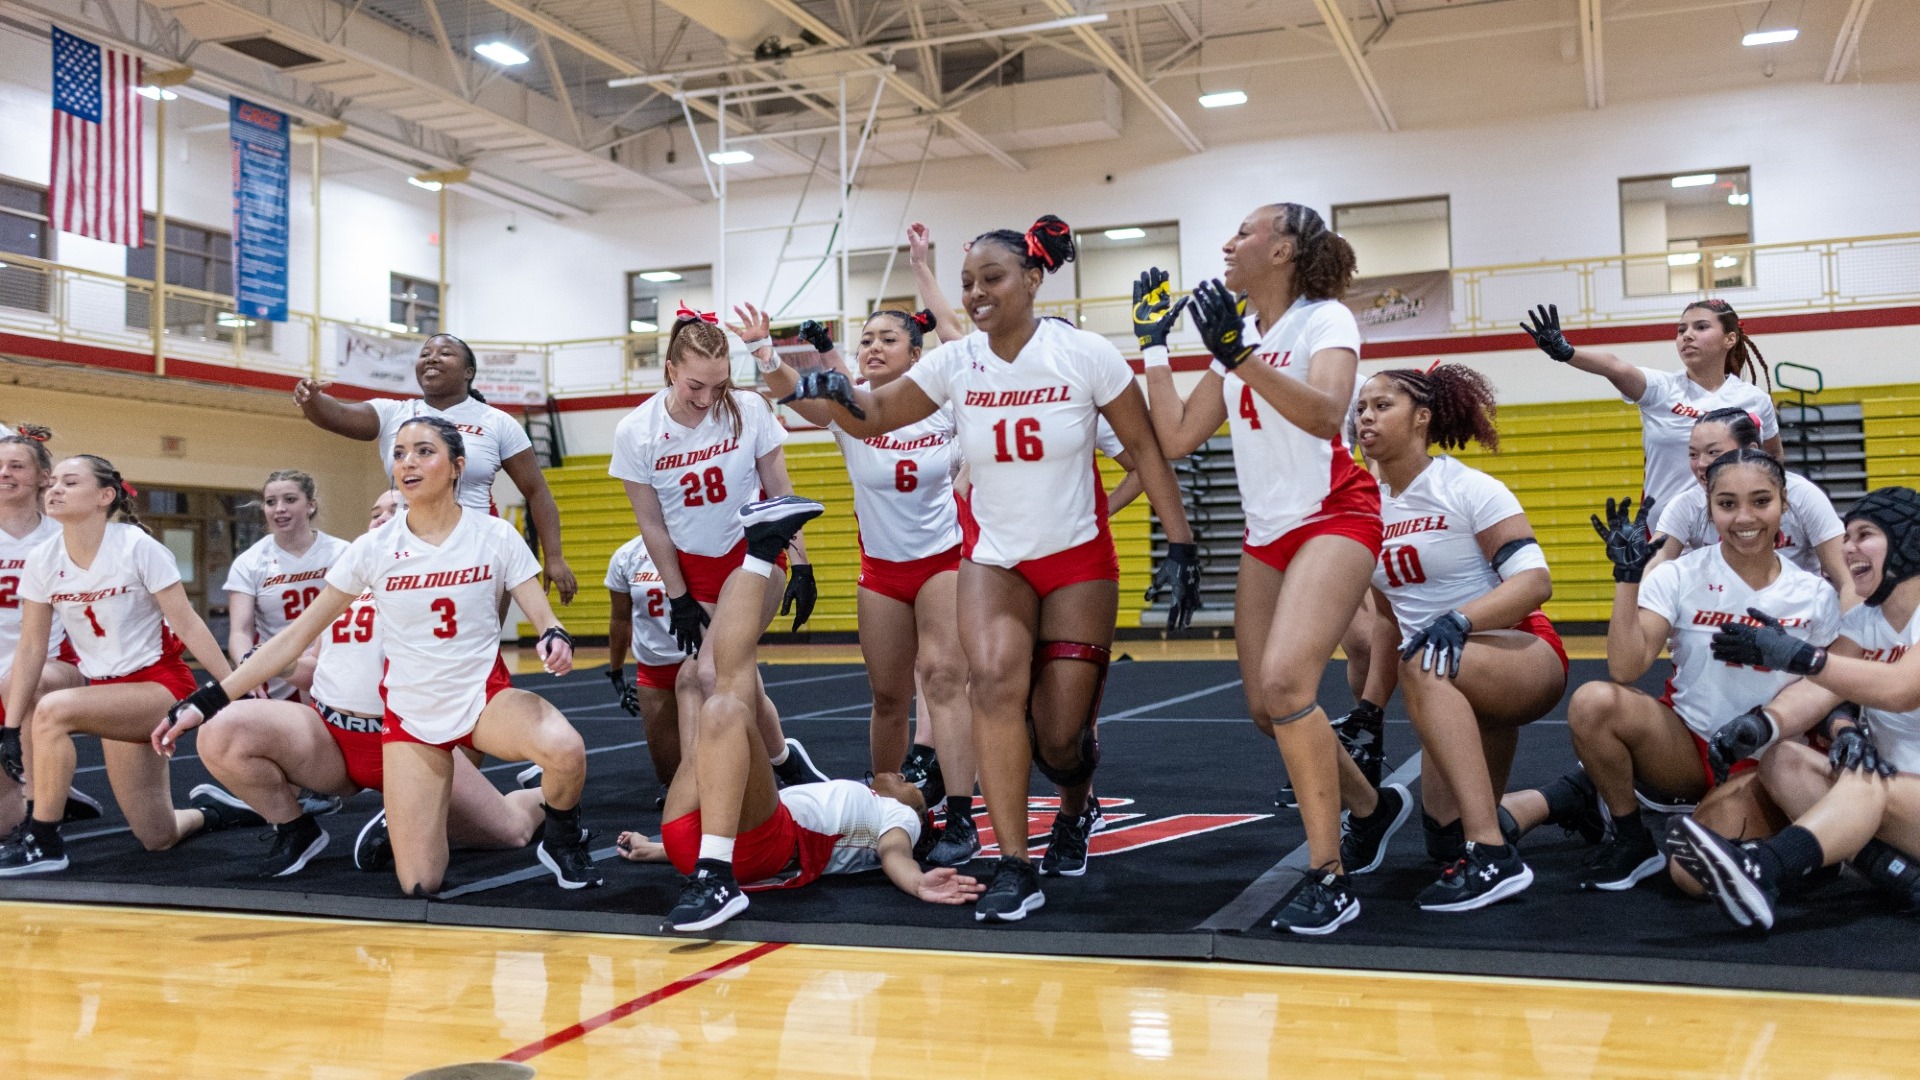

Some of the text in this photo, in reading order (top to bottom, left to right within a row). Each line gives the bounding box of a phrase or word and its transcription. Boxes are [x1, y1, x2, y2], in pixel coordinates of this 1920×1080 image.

[1239, 384, 1262, 430] 4
[993, 417, 1044, 462] 16
[680, 466, 728, 507] 28
[895, 459, 918, 493] 6
[1381, 545, 1427, 588] 10
[83, 605, 106, 637] 1
[332, 606, 376, 643] 29
[430, 597, 458, 640] 3
